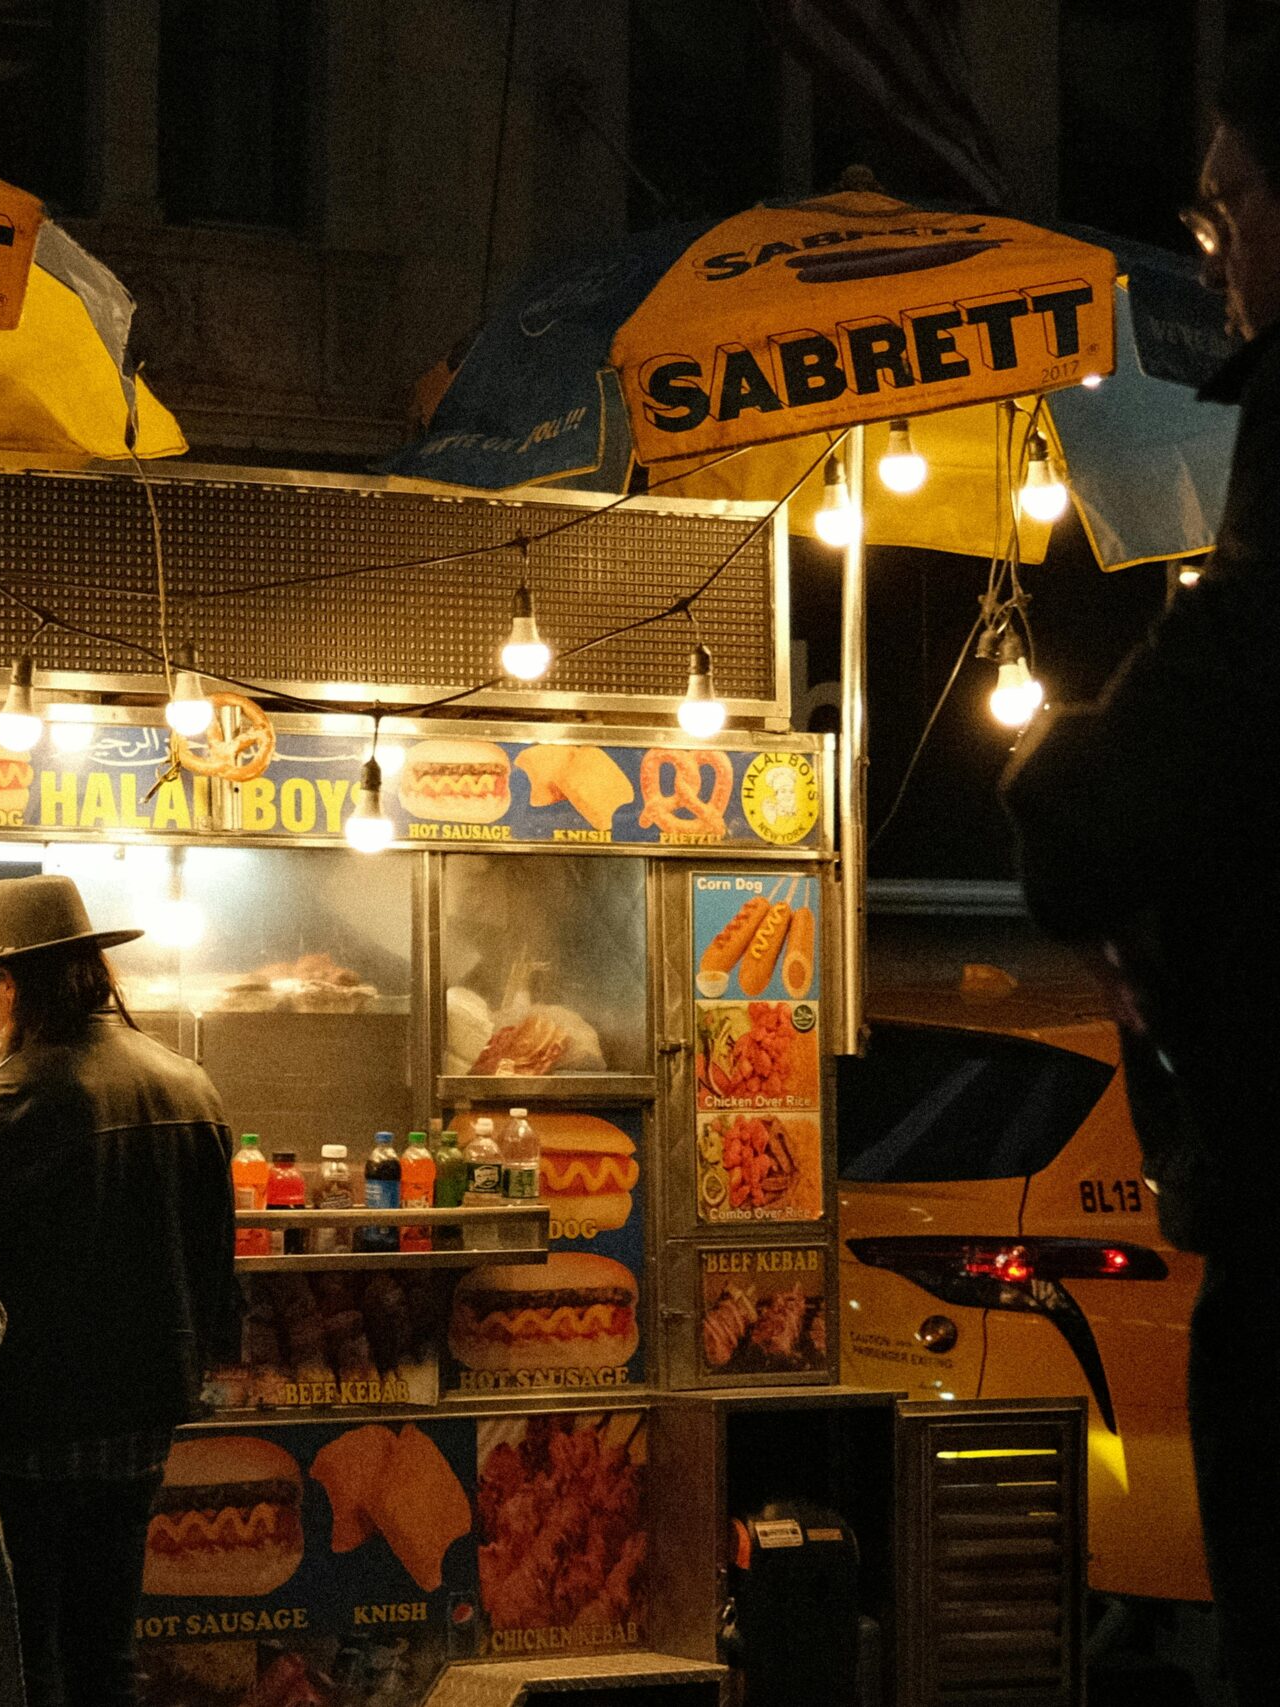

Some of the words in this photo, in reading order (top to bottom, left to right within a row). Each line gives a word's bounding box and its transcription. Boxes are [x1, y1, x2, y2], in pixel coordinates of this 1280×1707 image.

[638, 278, 1093, 434] SABRETT
[1041, 360, 1081, 385] 2017
[743, 752, 783, 799] HALAL
[788, 753, 816, 801] BOYS
[240, 776, 366, 834] BOY
[408, 824, 442, 840] HOT
[442, 824, 512, 842] SAUSAGE
[552, 829, 612, 844] KNISH
[697, 877, 731, 891] Corn
[735, 877, 764, 893] Dog
[704, 1096, 753, 1108] Chicken
[755, 1095, 783, 1108] Over
[786, 1095, 811, 1107] Rice
[709, 1207, 752, 1221] Combo
[754, 1206, 783, 1219] Over
[786, 1206, 810, 1218] Rice
[549, 1218, 599, 1240] DOG
[705, 1251, 753, 1274] BEEF
[756, 1250, 819, 1272] KEBAB
[459, 1367, 511, 1391] HOT
[517, 1365, 630, 1389] SAUSAGE
[285, 1380, 335, 1405] BEEF
[336, 1378, 410, 1403] KEBAB
[186, 1606, 309, 1636] SAUSAGE
[352, 1601, 429, 1626] KNISH
[491, 1627, 572, 1654] CHICKEN
[577, 1621, 640, 1647] KEBAB
